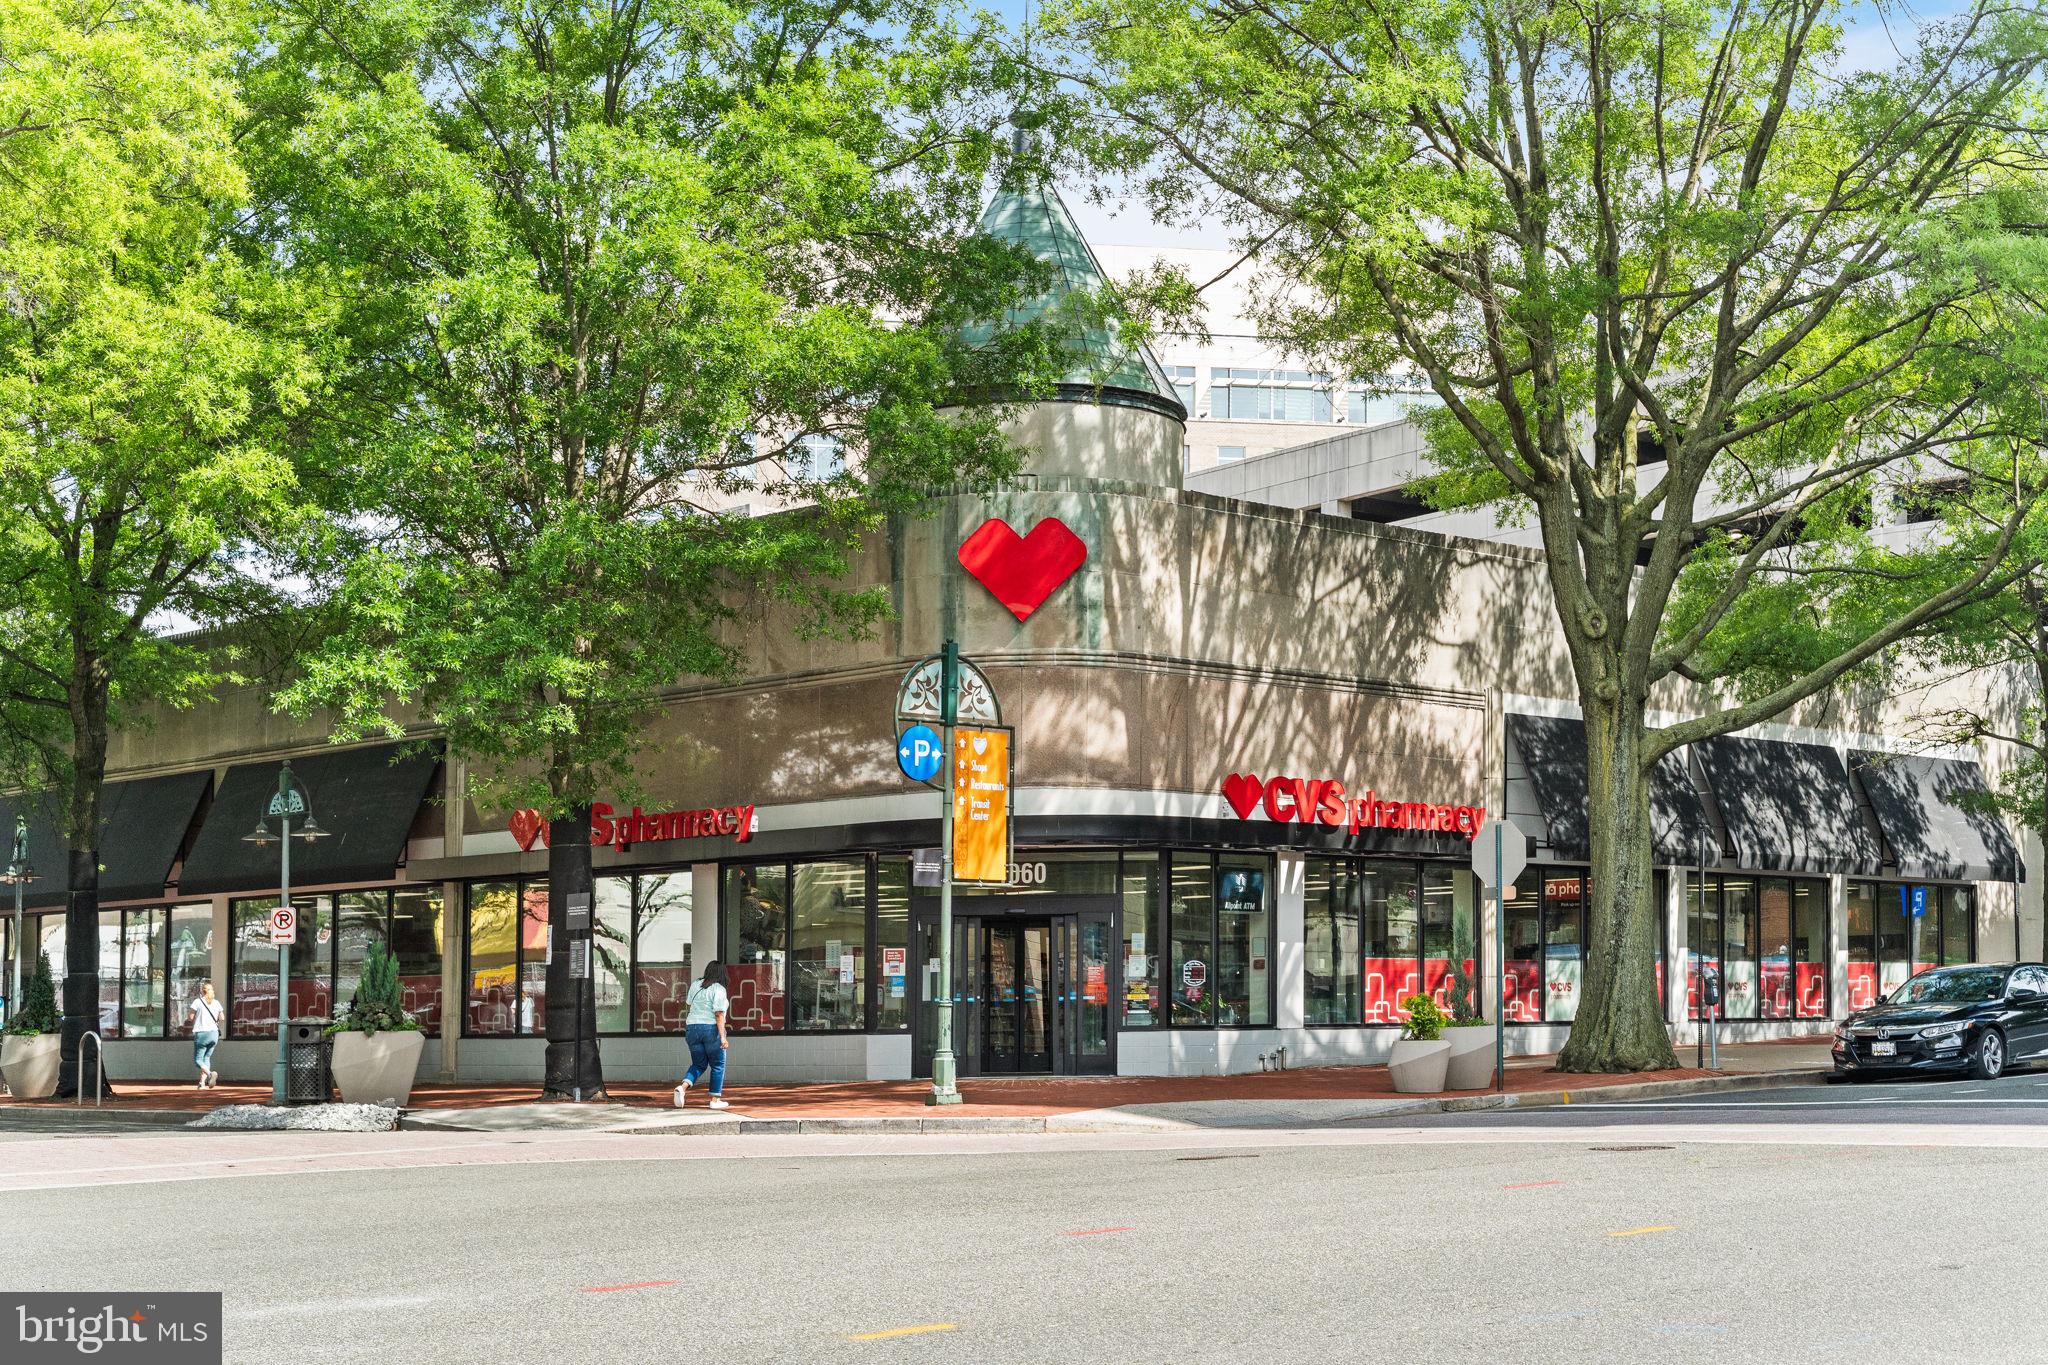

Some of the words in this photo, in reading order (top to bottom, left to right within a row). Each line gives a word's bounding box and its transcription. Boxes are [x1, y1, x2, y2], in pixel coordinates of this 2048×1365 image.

[914, 739, 931, 767] P
[971, 760, 988, 774] Shops
[970, 778, 1005, 790] Restaurants
[971, 795, 990, 808] Transit
[970, 808, 989, 820] Center
[1263, 776, 1347, 826] CVS
[1348, 790, 1486, 842] pharmacy
[615, 804, 755, 852] pharmacy
[1556, 982, 1573, 992] CVS
[1734, 981, 1748, 991] CVS
